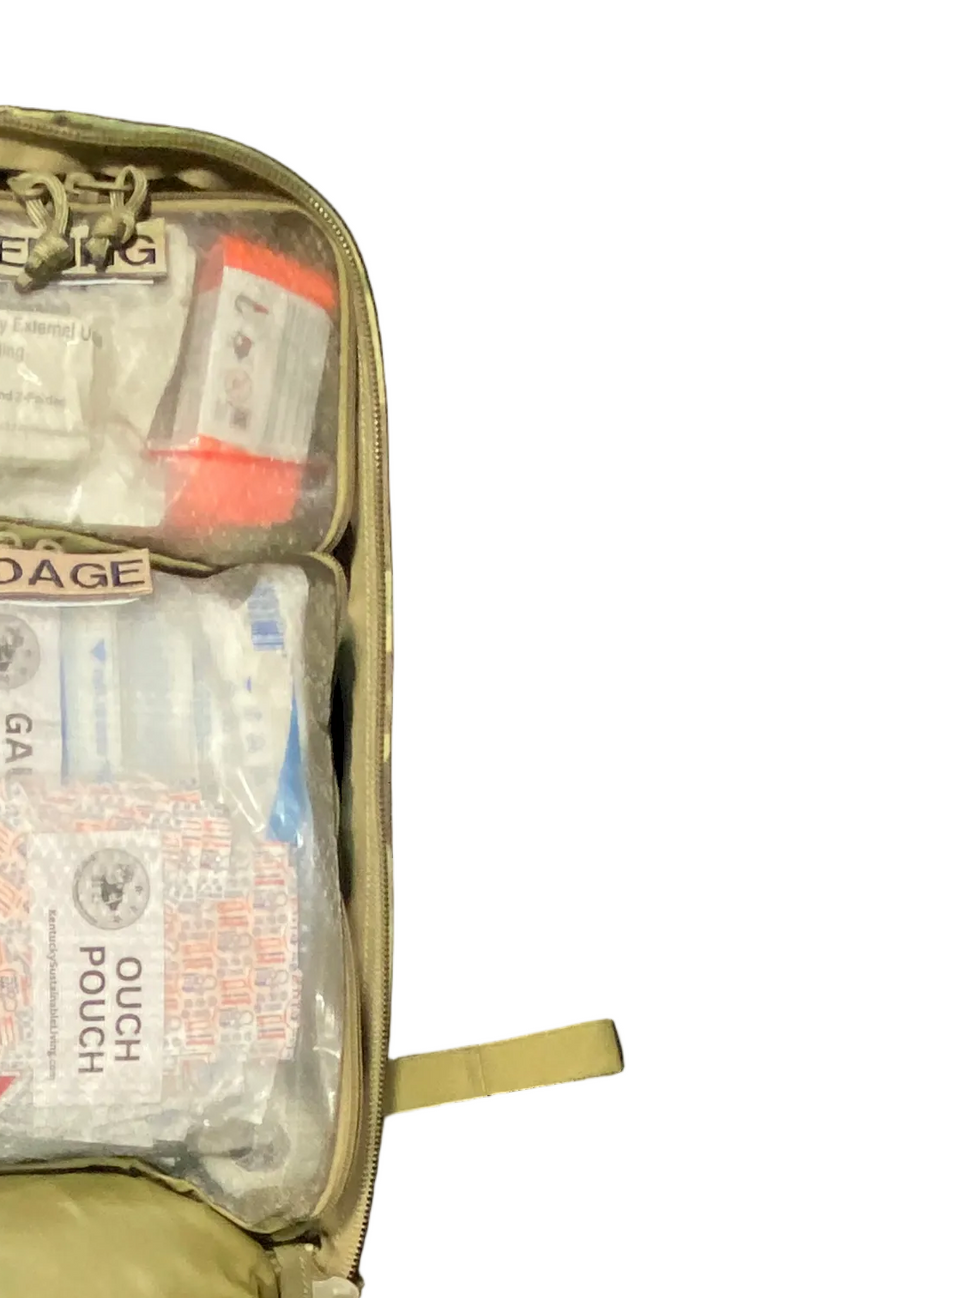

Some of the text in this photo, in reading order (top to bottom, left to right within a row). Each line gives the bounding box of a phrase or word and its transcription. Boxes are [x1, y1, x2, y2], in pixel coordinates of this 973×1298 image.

[12, 318, 75, 340] External
[77, 946, 105, 1074] POUCH
[113, 956, 142, 1062] OUCH
